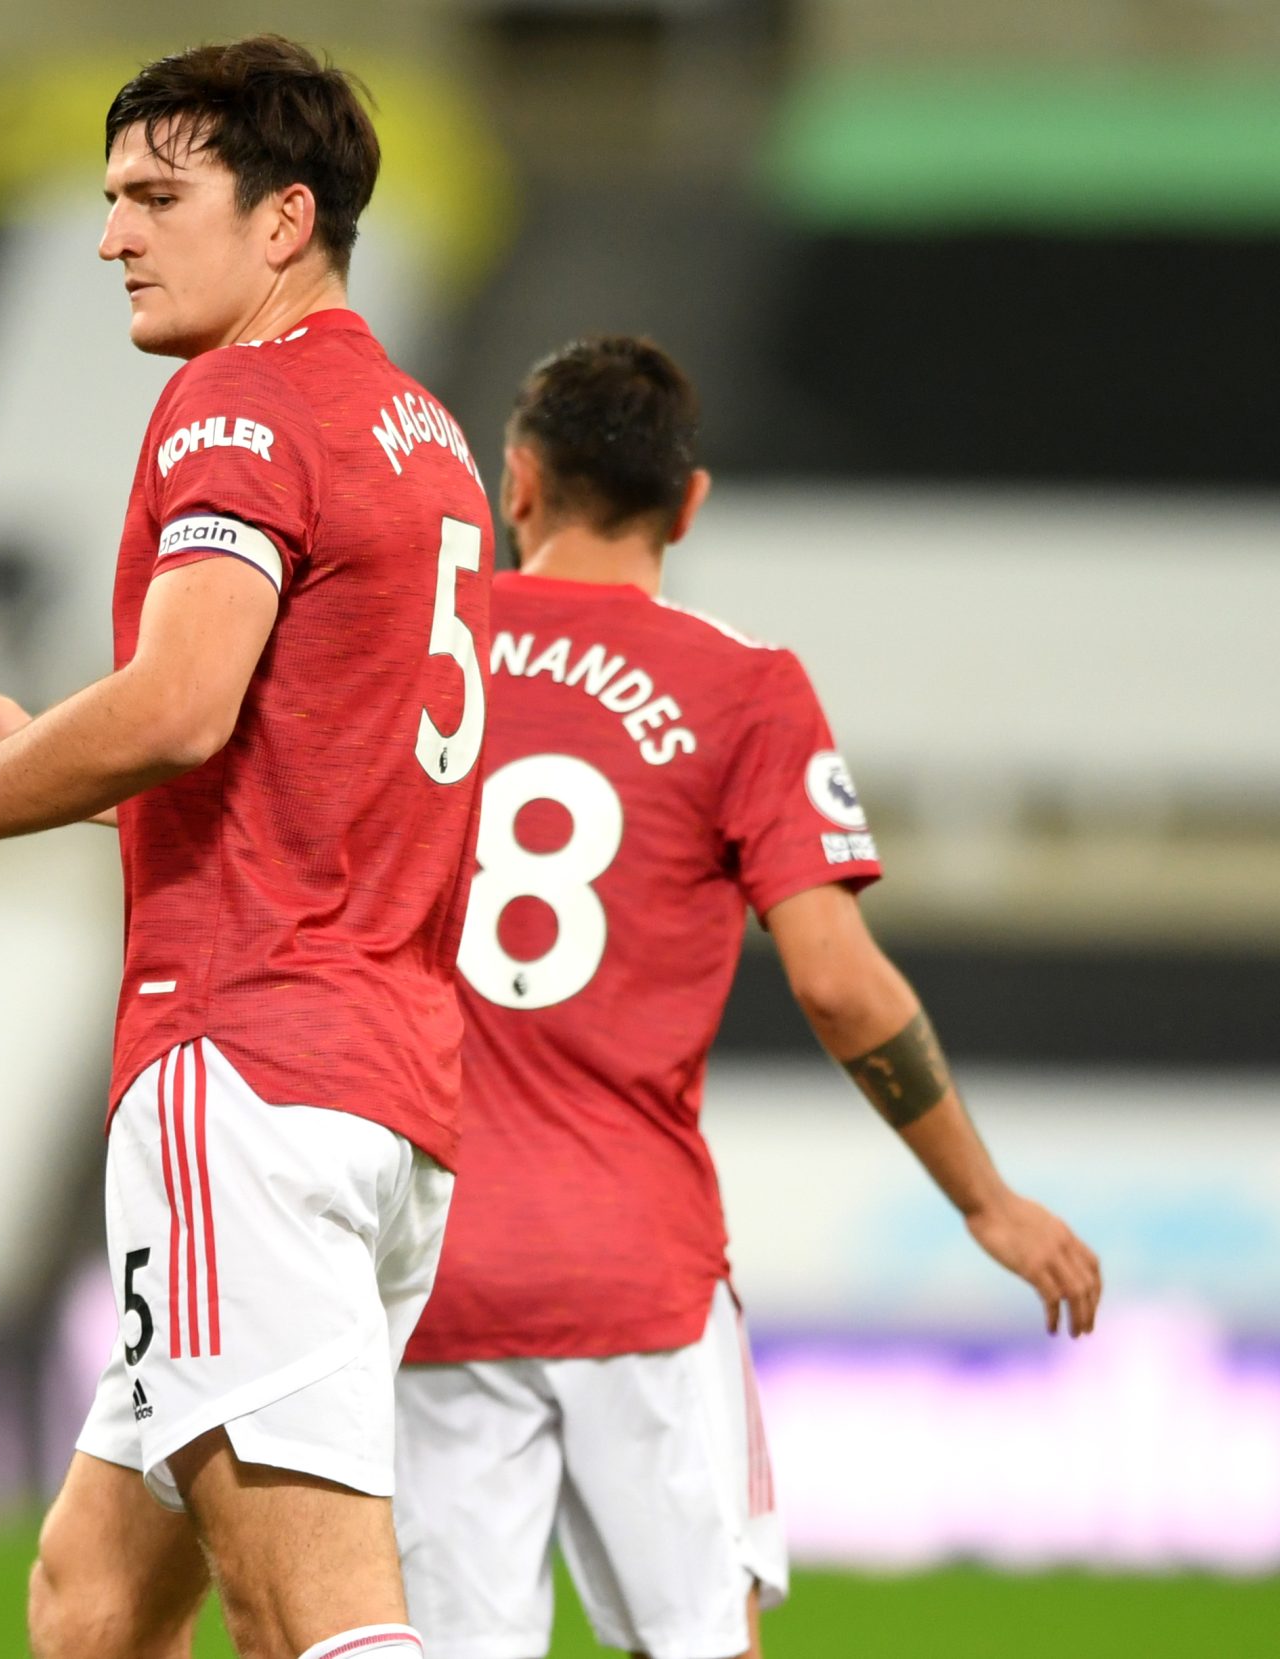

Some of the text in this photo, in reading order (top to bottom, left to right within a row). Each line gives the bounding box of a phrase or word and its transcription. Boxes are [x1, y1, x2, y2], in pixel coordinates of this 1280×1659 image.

[157, 416, 274, 478] KOHLER
[372, 391, 487, 497] MAGUIR
[160, 521, 238, 553] ptain
[414, 516, 485, 785] 5
[489, 631, 697, 767] NANDES
[124, 1247, 154, 1367] 5
